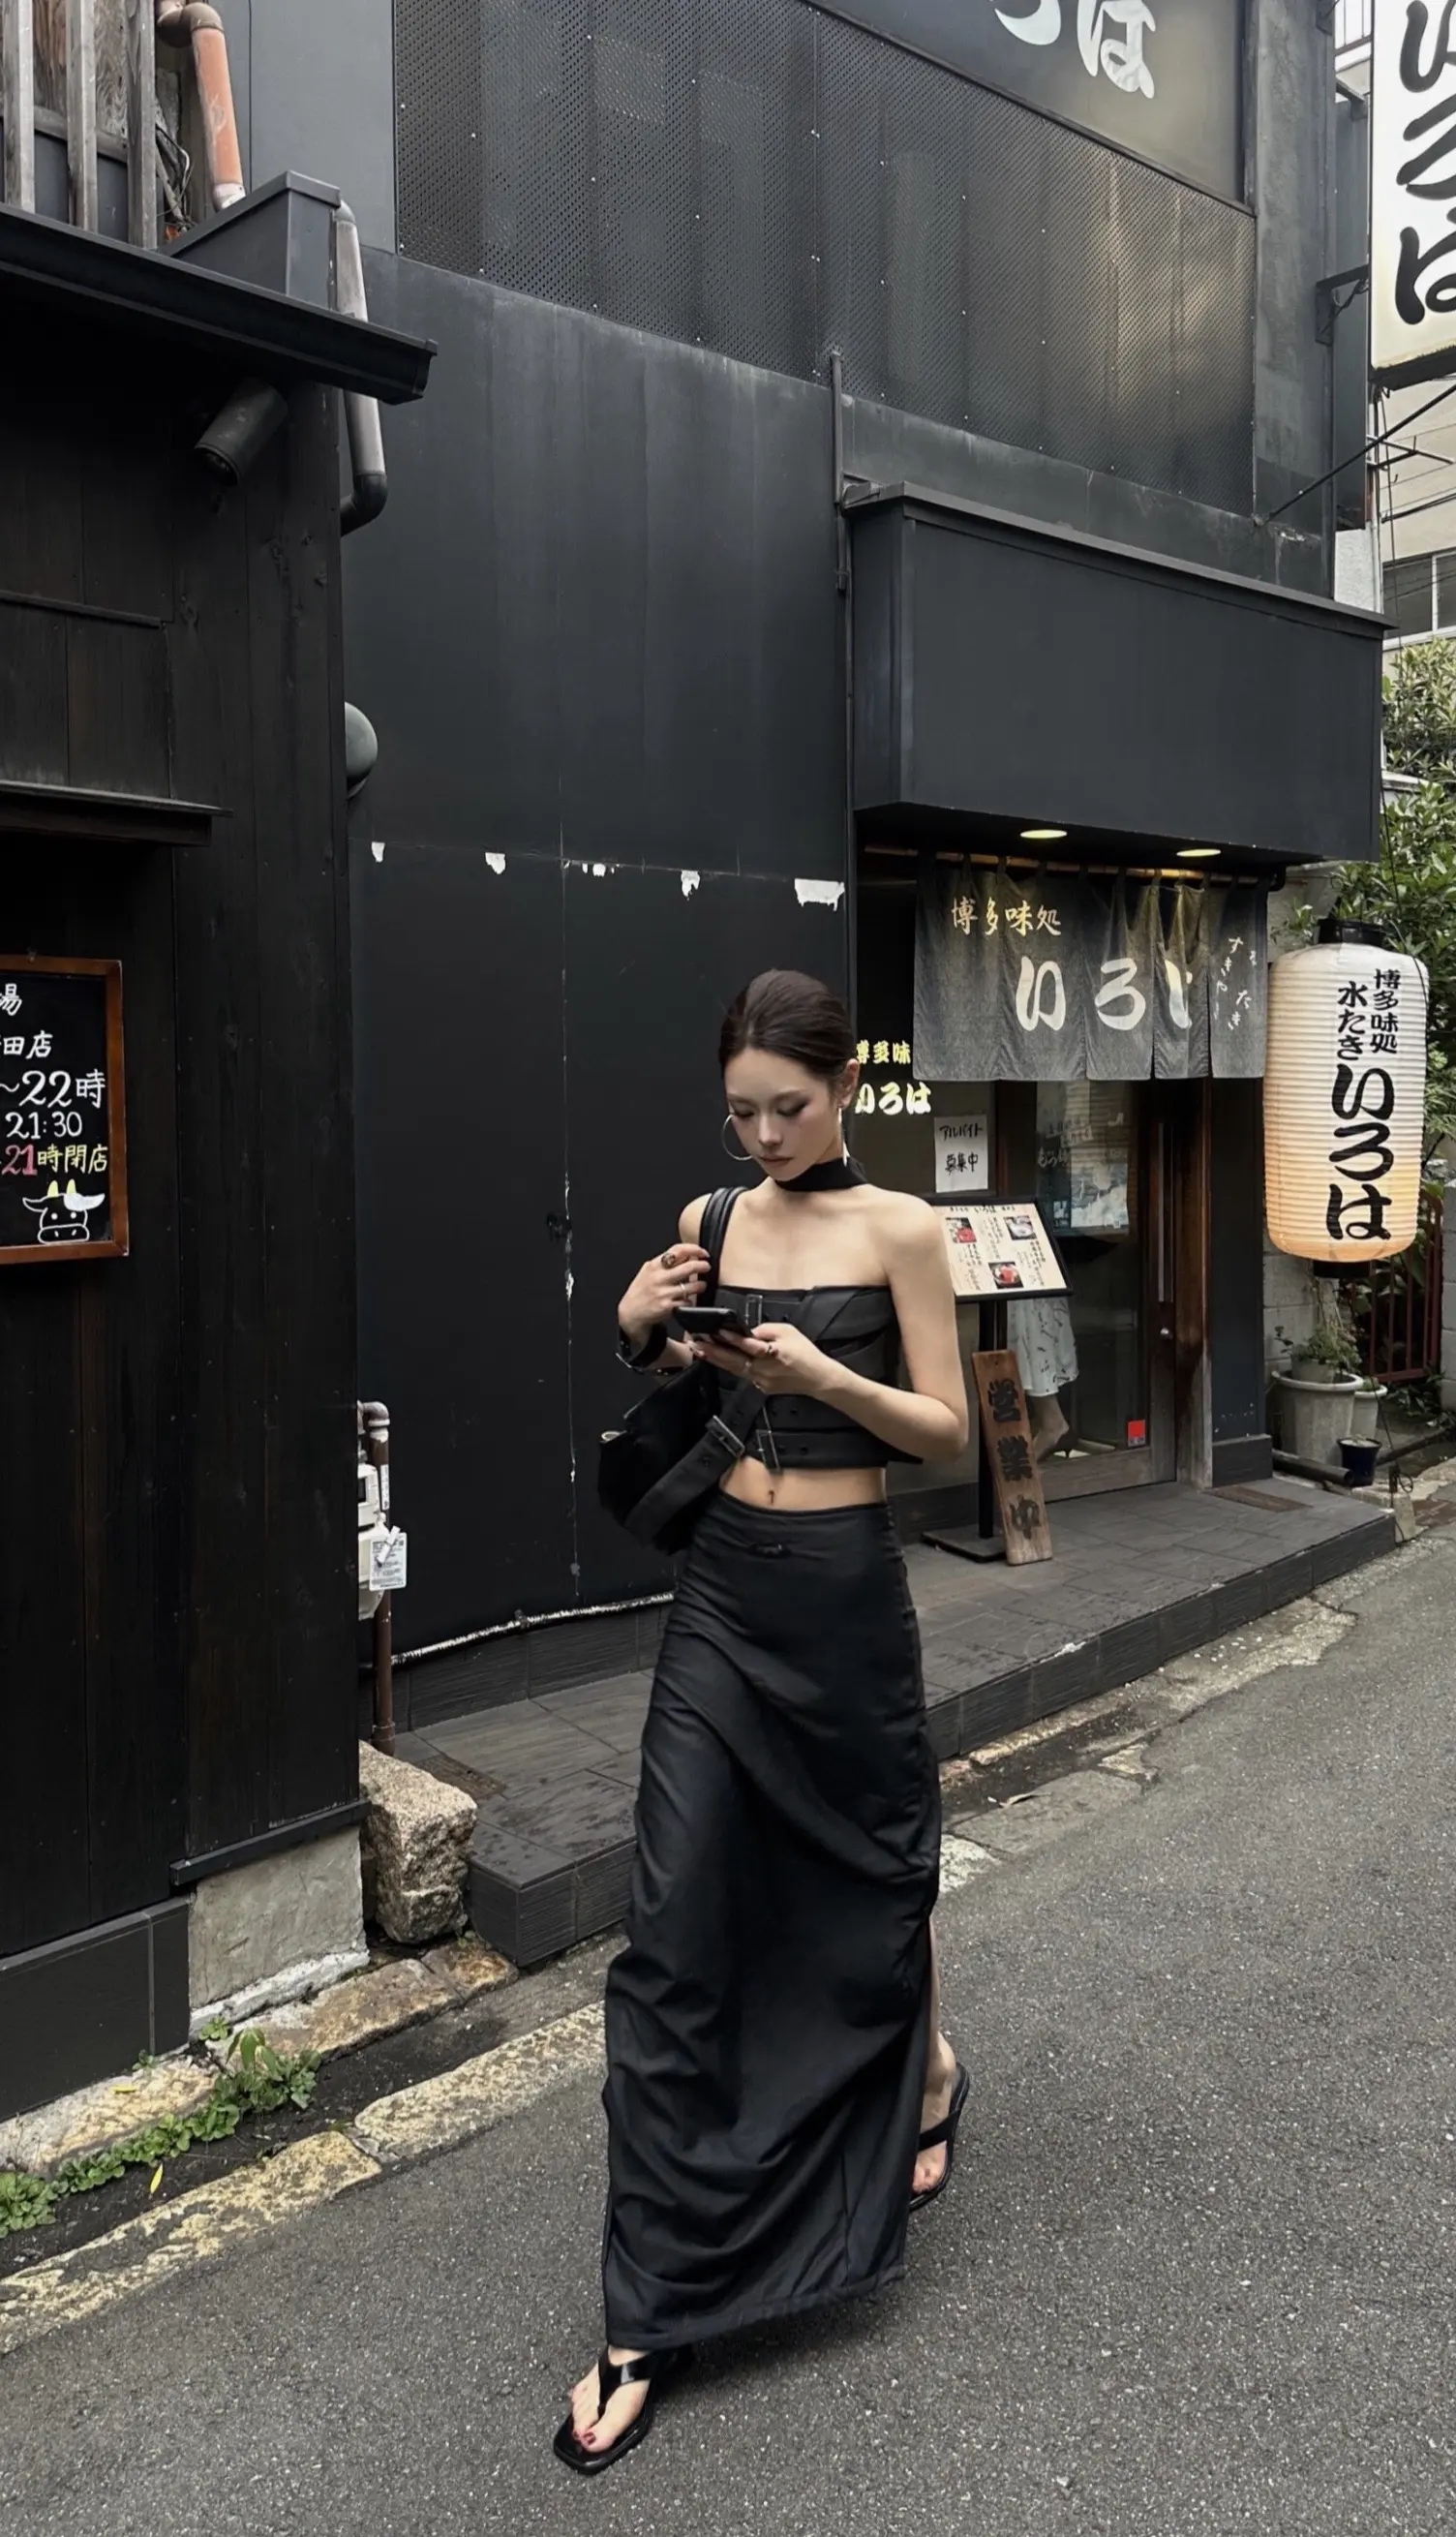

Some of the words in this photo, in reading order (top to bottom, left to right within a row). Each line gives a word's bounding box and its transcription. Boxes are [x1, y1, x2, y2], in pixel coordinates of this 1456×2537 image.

[952, 897, 1062, 937] 博多味処
[1336, 980, 1368, 1061] 水たき
[1369, 968, 1402, 1055] 博多味処
[0, 1029, 53, 1059] 田店
[5, 1111, 82, 1140] 21:30
[945, 1151, 979, 1176] 募集中
[1325, 1064, 1395, 1240] いろは
